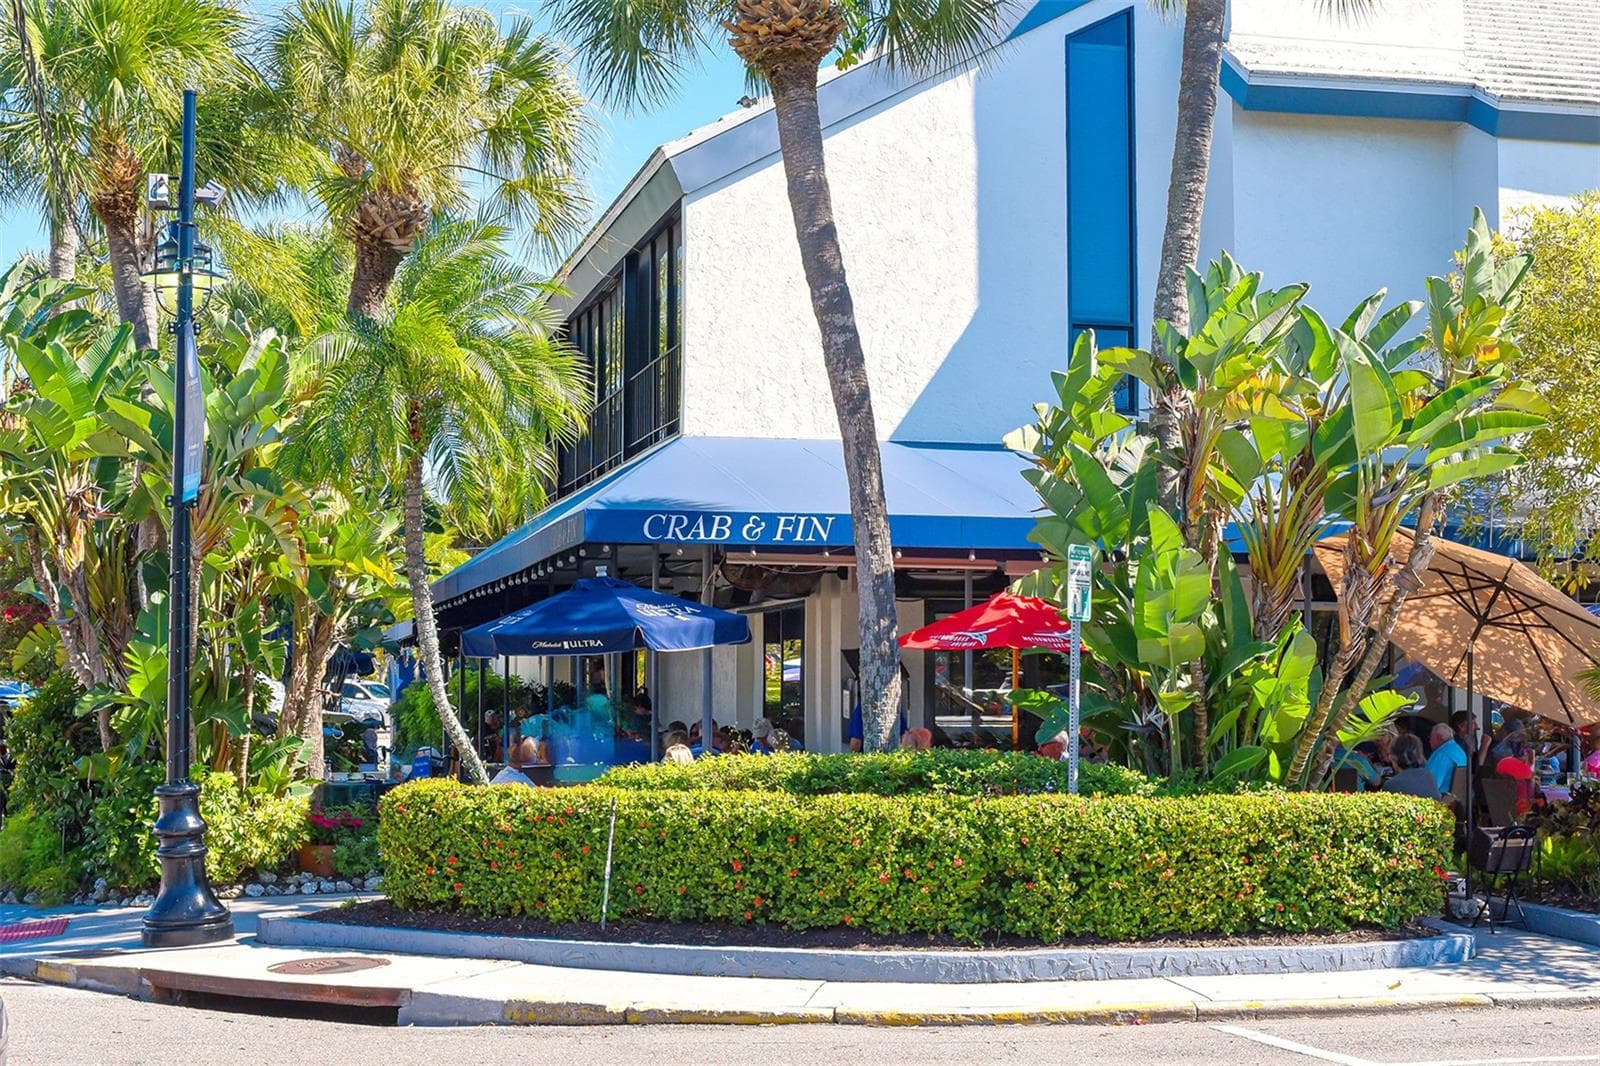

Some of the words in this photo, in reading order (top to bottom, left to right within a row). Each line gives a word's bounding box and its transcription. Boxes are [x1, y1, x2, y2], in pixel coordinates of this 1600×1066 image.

[643, 513, 733, 541] CRAB
[742, 515, 766, 541] &
[772, 513, 835, 542] FIN
[569, 640, 604, 648] ULTRA
